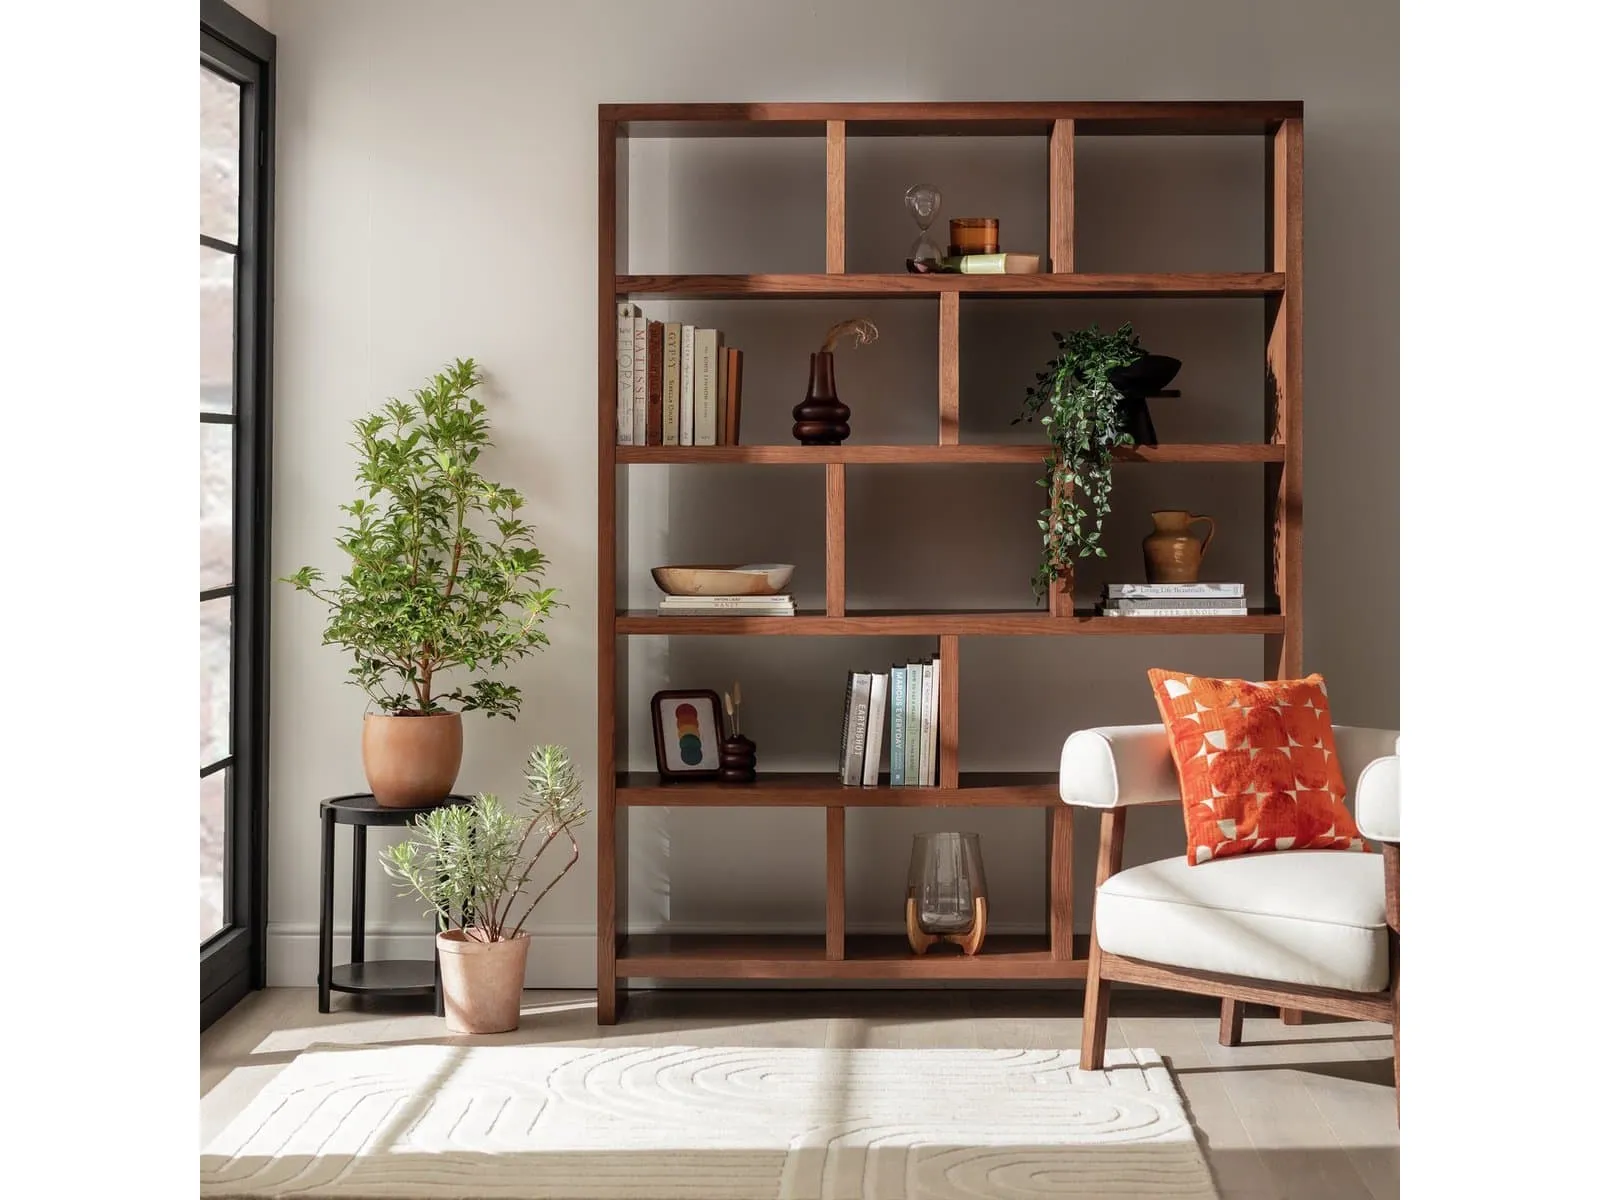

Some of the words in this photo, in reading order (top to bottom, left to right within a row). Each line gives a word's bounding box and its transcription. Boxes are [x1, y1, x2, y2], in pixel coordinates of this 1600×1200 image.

[635, 330, 645, 405] MATISSE
[667, 332, 677, 370] GYPSY
[895, 671, 903, 706] MARCUS
[854, 703, 866, 755] EARTHSHOT
[895, 707, 903, 750] EVERYDAY
